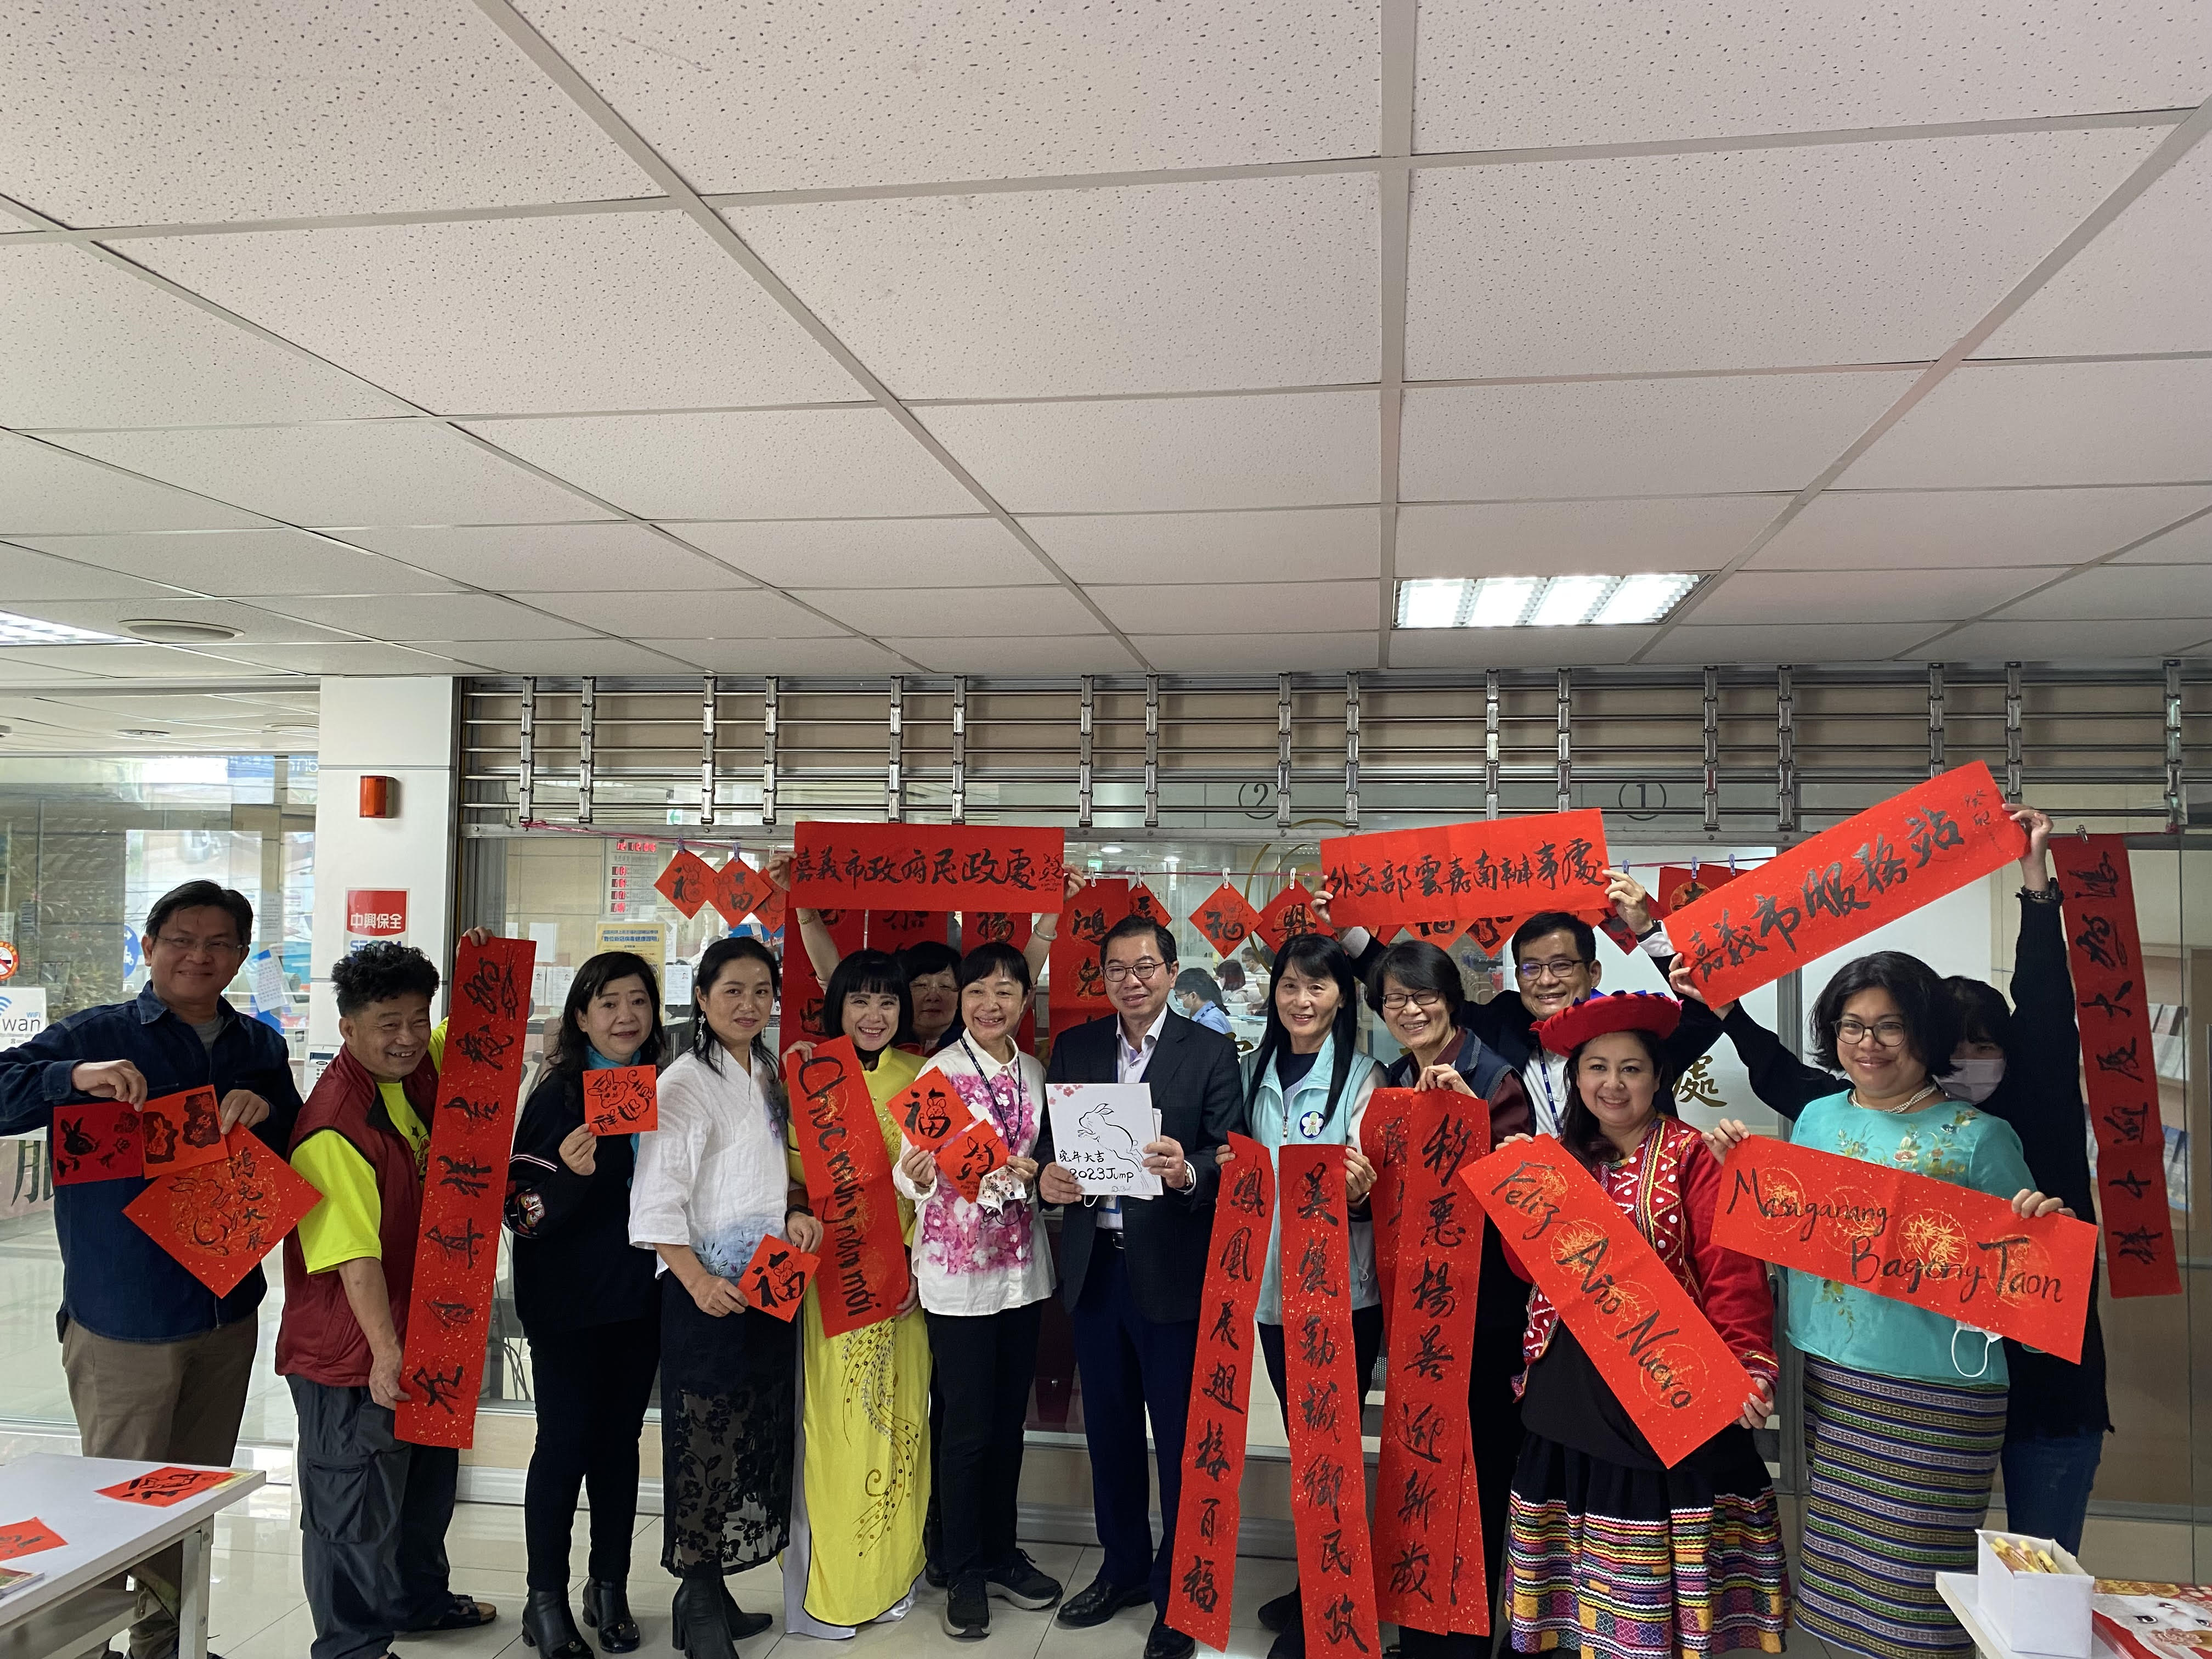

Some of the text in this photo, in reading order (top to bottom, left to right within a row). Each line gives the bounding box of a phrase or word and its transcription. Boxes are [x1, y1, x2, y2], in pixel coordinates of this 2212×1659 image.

[793, 847, 1037, 891] 嘉義市政府民政處
[1329, 838, 1605, 903] 外交部雲嘉南辦事處
[1689, 808, 1964, 983] 嘉義市服務站
[351, 913, 402, 929] 中興保全
[1059, 1149, 1105, 1163] 兔年大吉
[1491, 1160, 1561, 1240] Feliz
[1616, 1309, 1692, 1408] Nuevo
[1977, 1237, 2063, 1303] Taon
